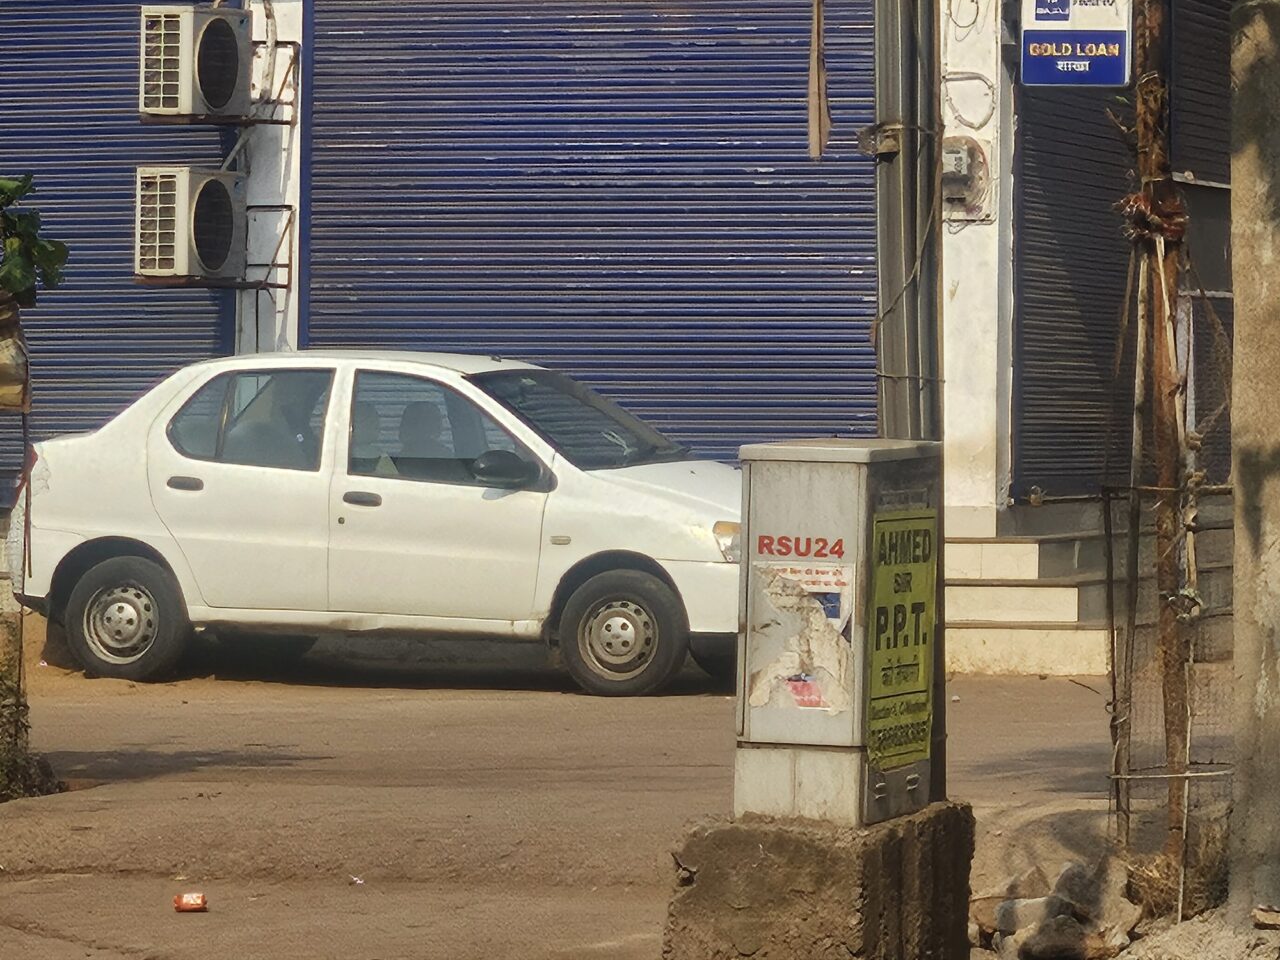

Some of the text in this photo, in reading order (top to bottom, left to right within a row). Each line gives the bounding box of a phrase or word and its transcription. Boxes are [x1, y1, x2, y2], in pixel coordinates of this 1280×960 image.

[1029, 43, 1119, 56] GOLD LOAN
[757, 534, 845, 559] RSU24
[879, 528, 931, 566] AHMED
[875, 601, 928, 652] P.P.T.
